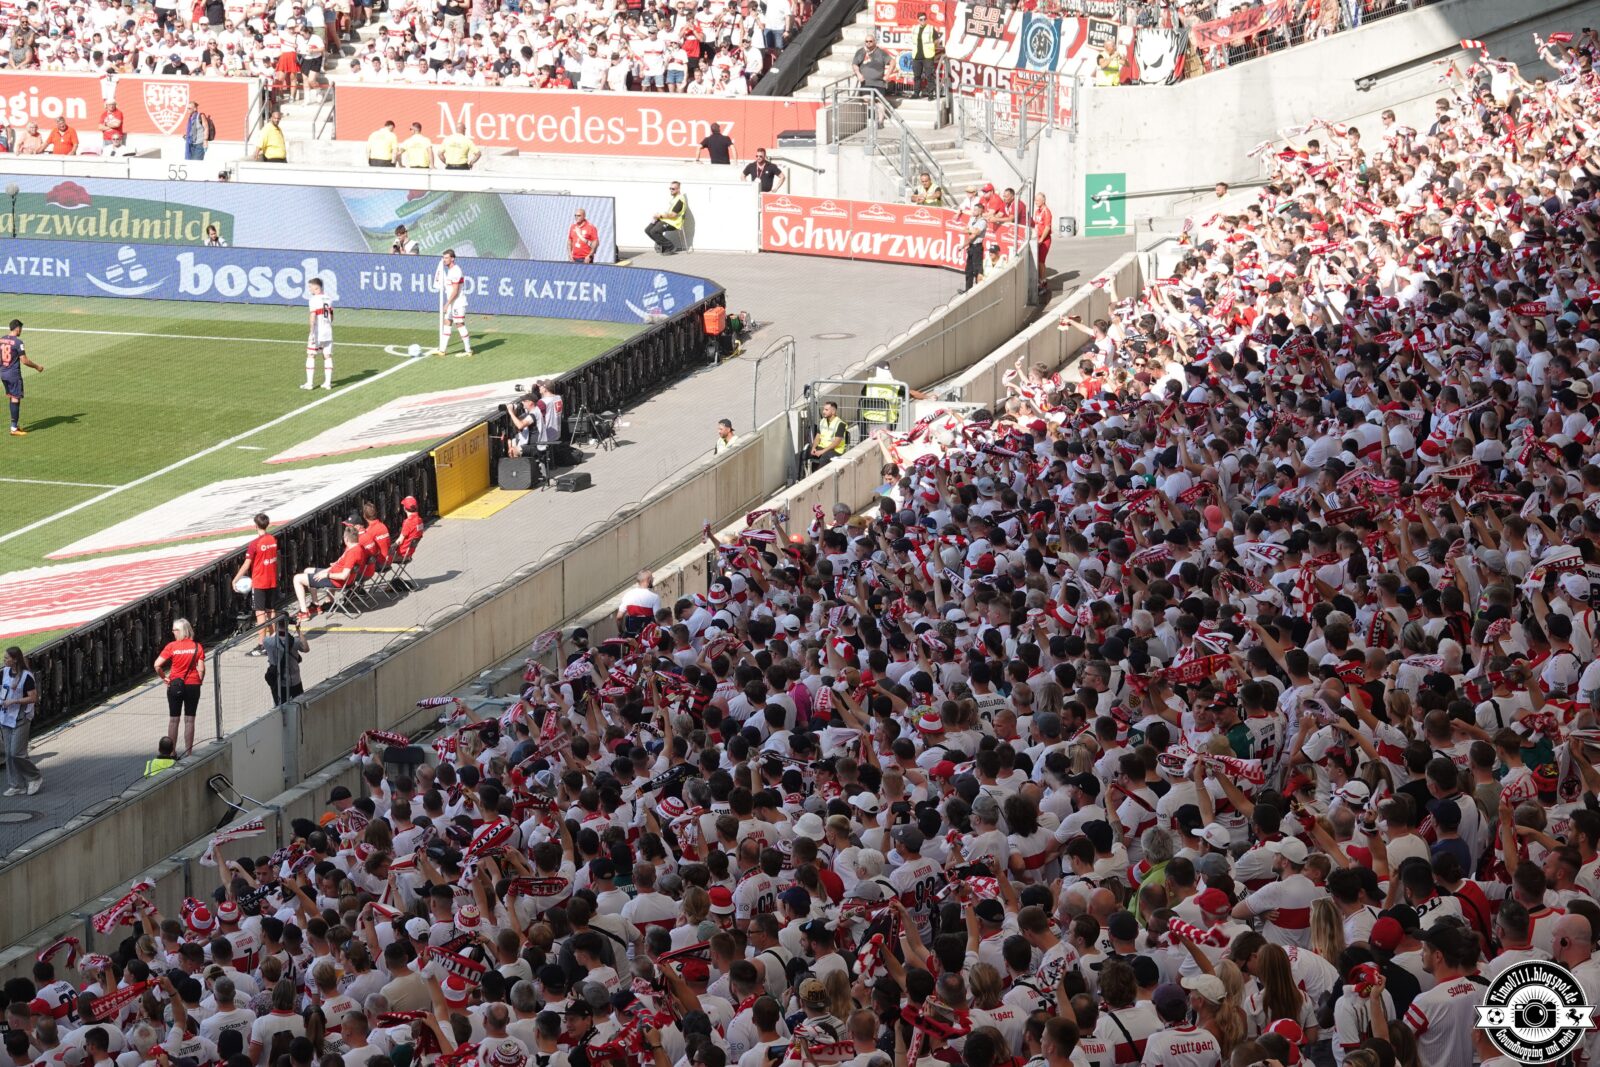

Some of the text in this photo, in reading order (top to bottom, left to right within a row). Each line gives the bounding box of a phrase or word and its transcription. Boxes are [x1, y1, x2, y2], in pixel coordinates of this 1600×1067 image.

[168, 164, 188, 181] 55
[0, 256, 70, 278] ATZEN
[176, 252, 340, 301] bosch
[360, 265, 607, 303] FÜR HUDE & KATZEN
[1170, 1040, 1215, 1056] Stuttgart
